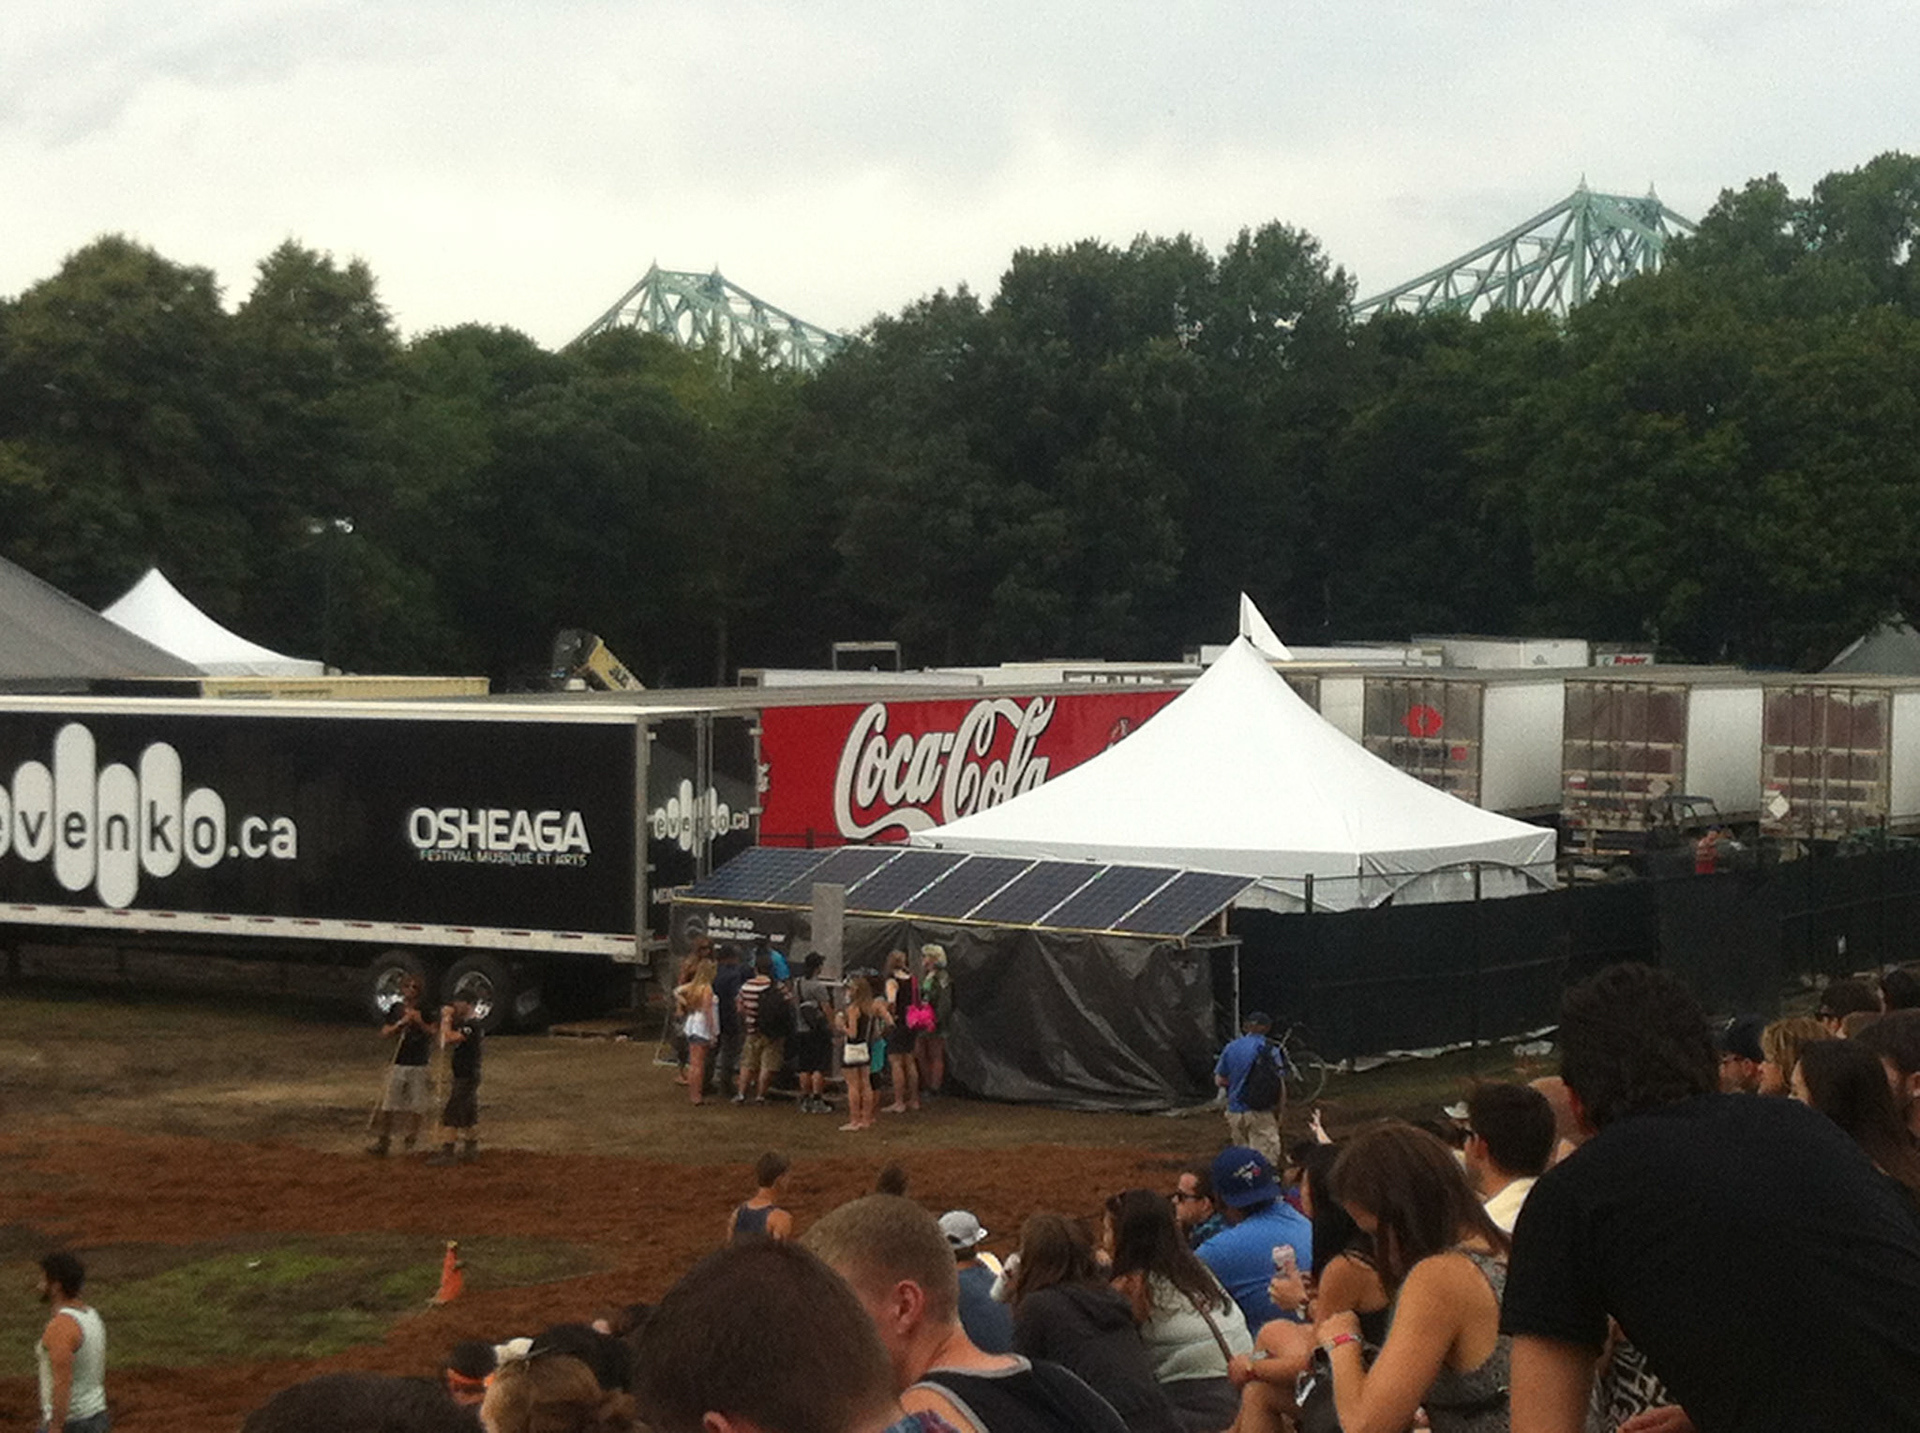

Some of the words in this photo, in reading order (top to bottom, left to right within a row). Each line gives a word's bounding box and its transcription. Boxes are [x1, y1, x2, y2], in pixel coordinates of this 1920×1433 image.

[834, 696, 1056, 839] Coca-Cola
[409, 807, 591, 854] OSHEAGA
[420, 849, 474, 863] FESTIVAL
[476, 850, 533, 866] MUSIQUE
[537, 852, 550, 865] ET
[554, 853, 587, 867] ARTS
